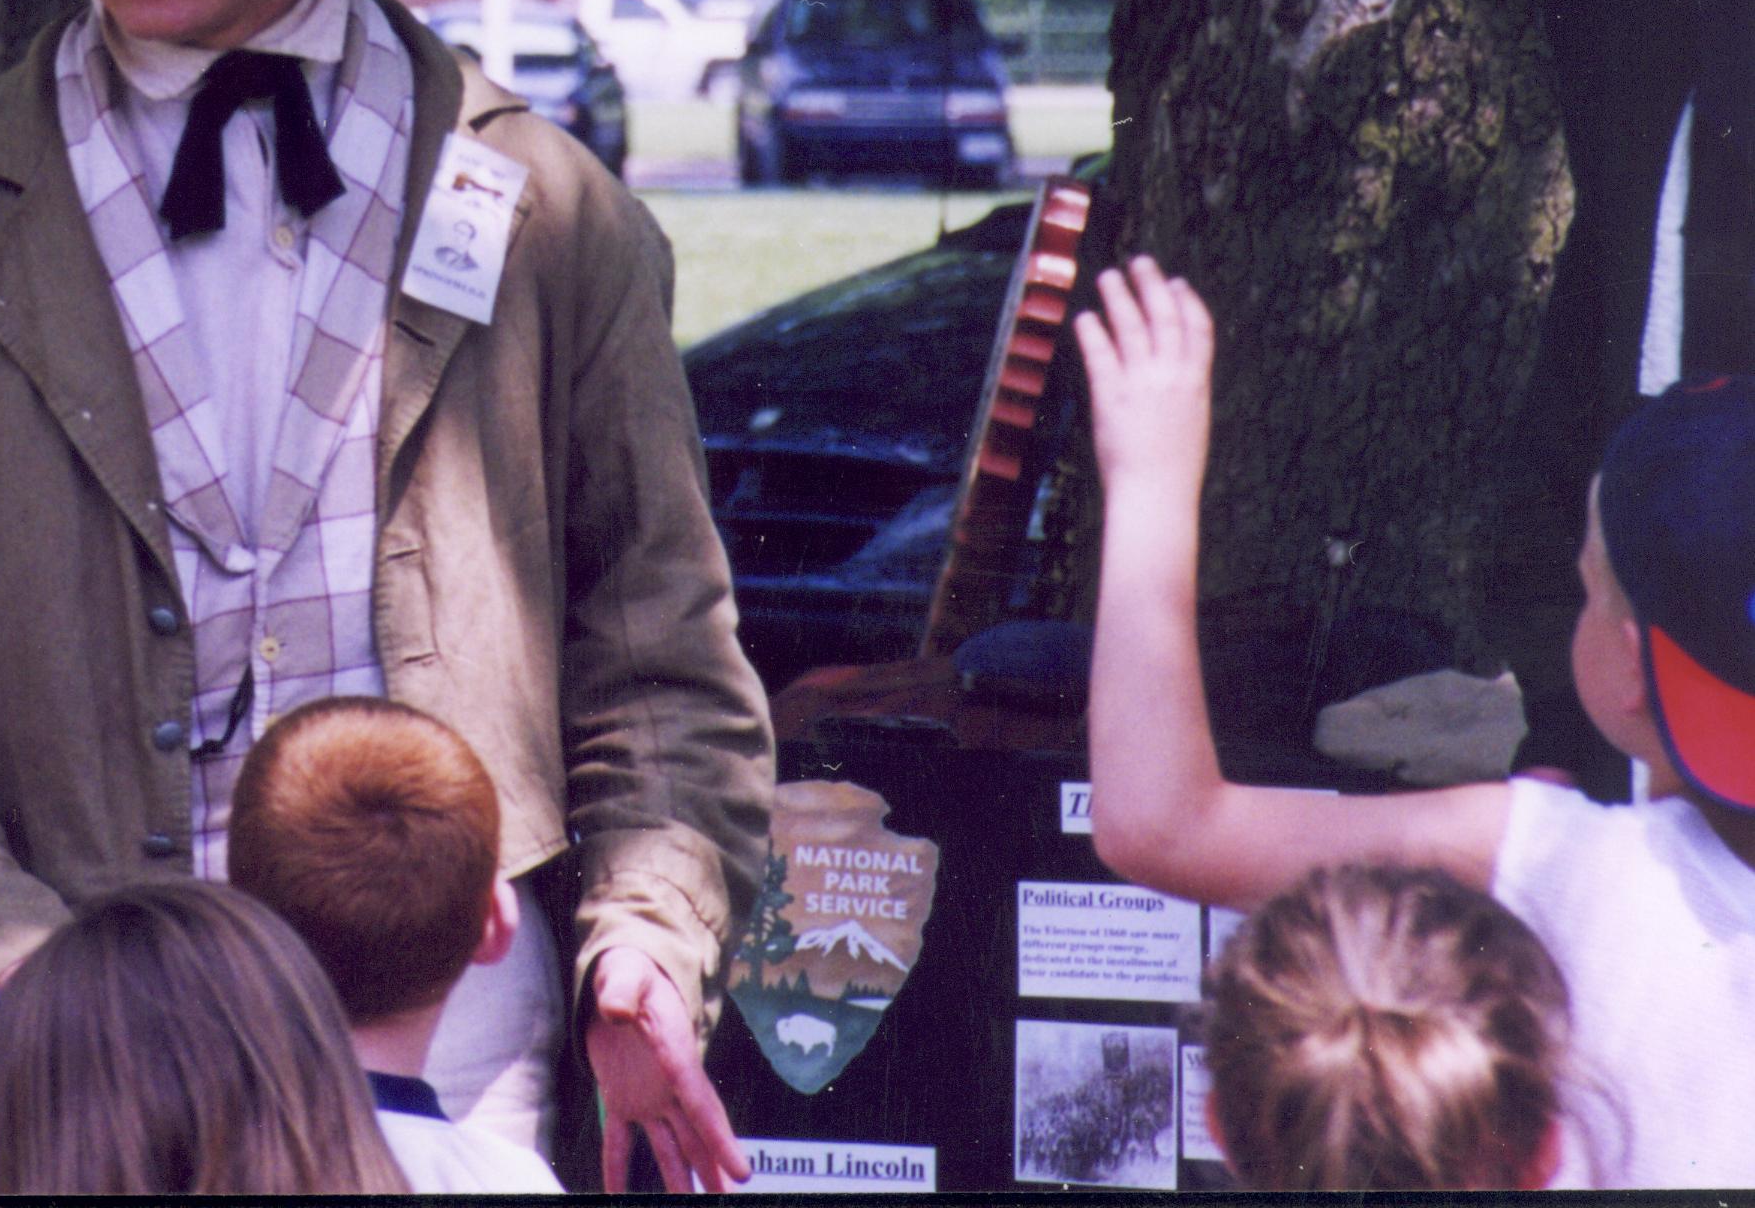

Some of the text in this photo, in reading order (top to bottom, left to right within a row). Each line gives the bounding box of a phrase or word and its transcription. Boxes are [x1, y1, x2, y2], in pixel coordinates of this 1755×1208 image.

[795, 845, 923, 875] NATIONAL
[824, 871, 891, 895] PARK
[804, 893, 908, 920] SERVICE
[1023, 888, 1165, 913] Political Groups
[1045, 925, 1086, 936] Election
[1090, 927, 1100, 937] of
[1152, 931, 1180, 942] many
[1022, 939, 1067, 950] different
[1070, 943, 1105, 953] groups
[1022, 953, 1071, 964] dedicated
[1074, 956, 1085, 964] to
[1087, 955, 1104, 965] the
[1167, 959, 1178, 968] of
[1050, 968, 1100, 979] candidate
[1103, 970, 1113, 980] to
[1116, 971, 1131, 981] the
[826, 1152, 926, 1180] Lincoln
